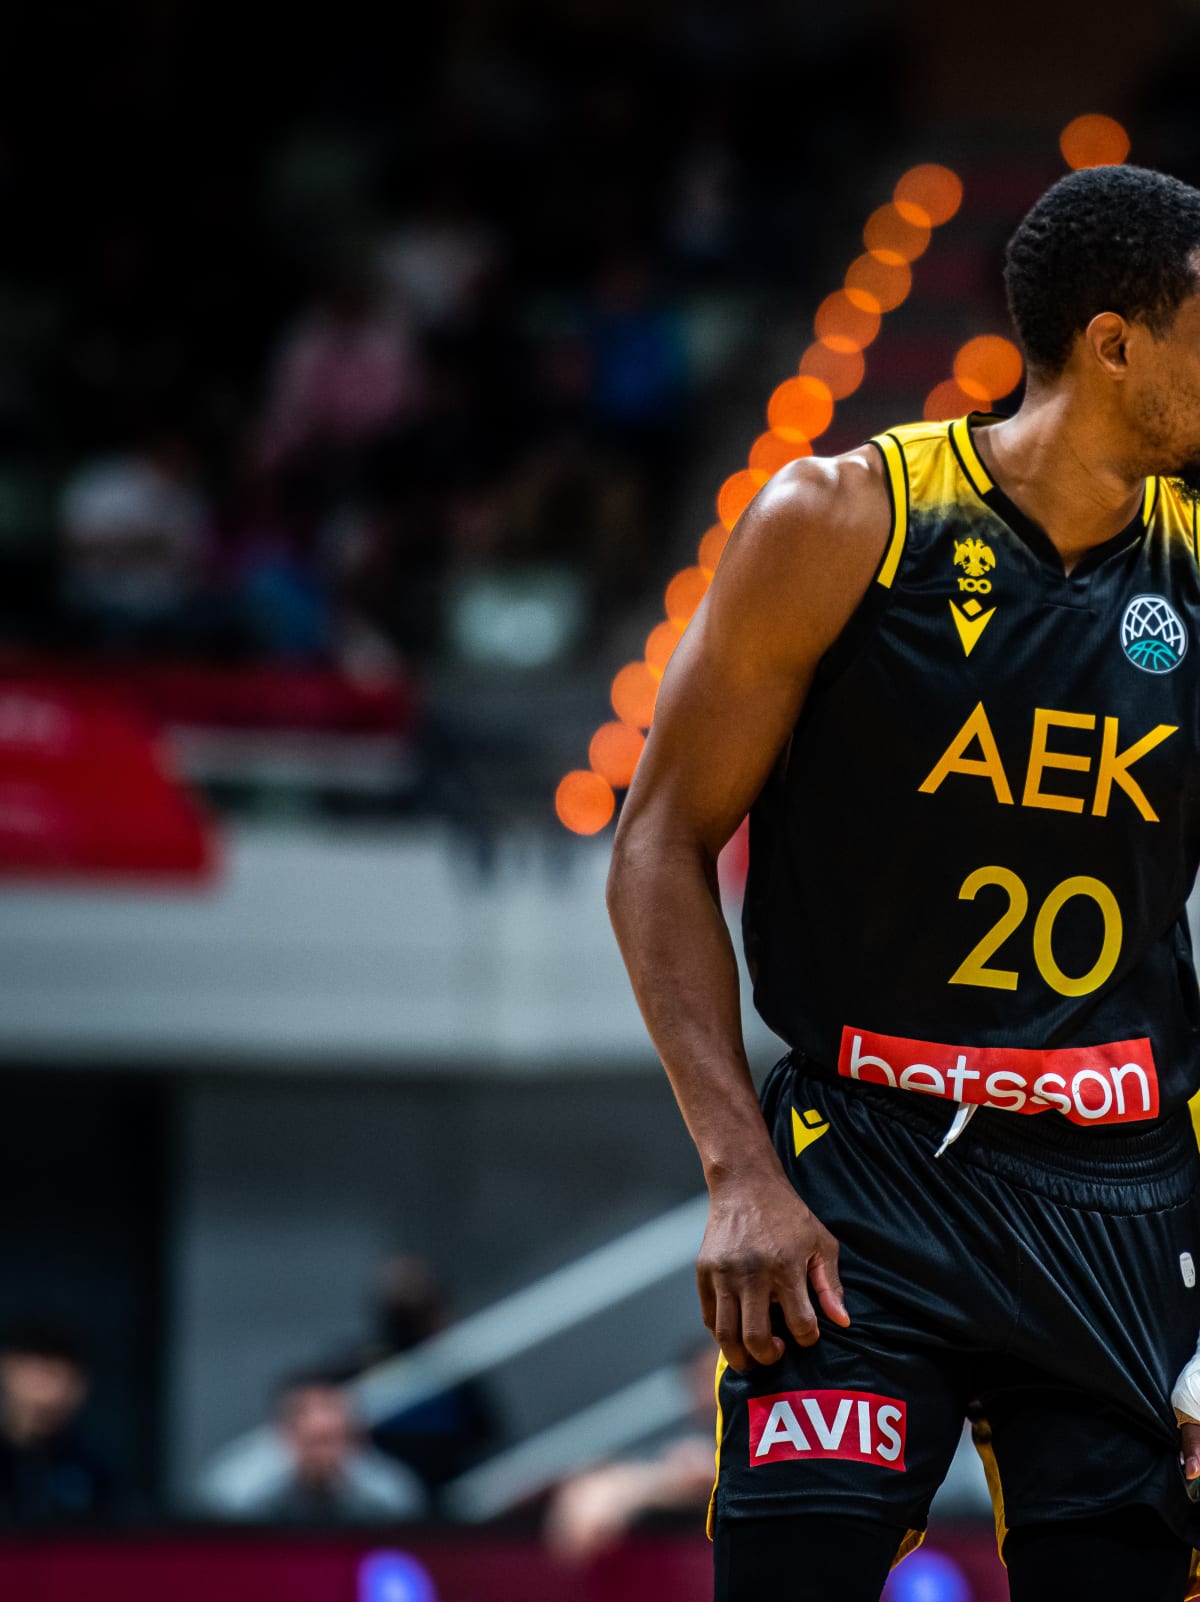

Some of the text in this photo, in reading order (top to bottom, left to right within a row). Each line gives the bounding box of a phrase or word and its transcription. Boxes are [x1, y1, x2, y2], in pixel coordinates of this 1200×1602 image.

[957, 577, 992, 594] 100
[918, 700, 1180, 822] AEK
[948, 866, 1122, 997] 20
[850, 1035, 1150, 1119] betsson
[755, 1398, 902, 1461] AVIS
